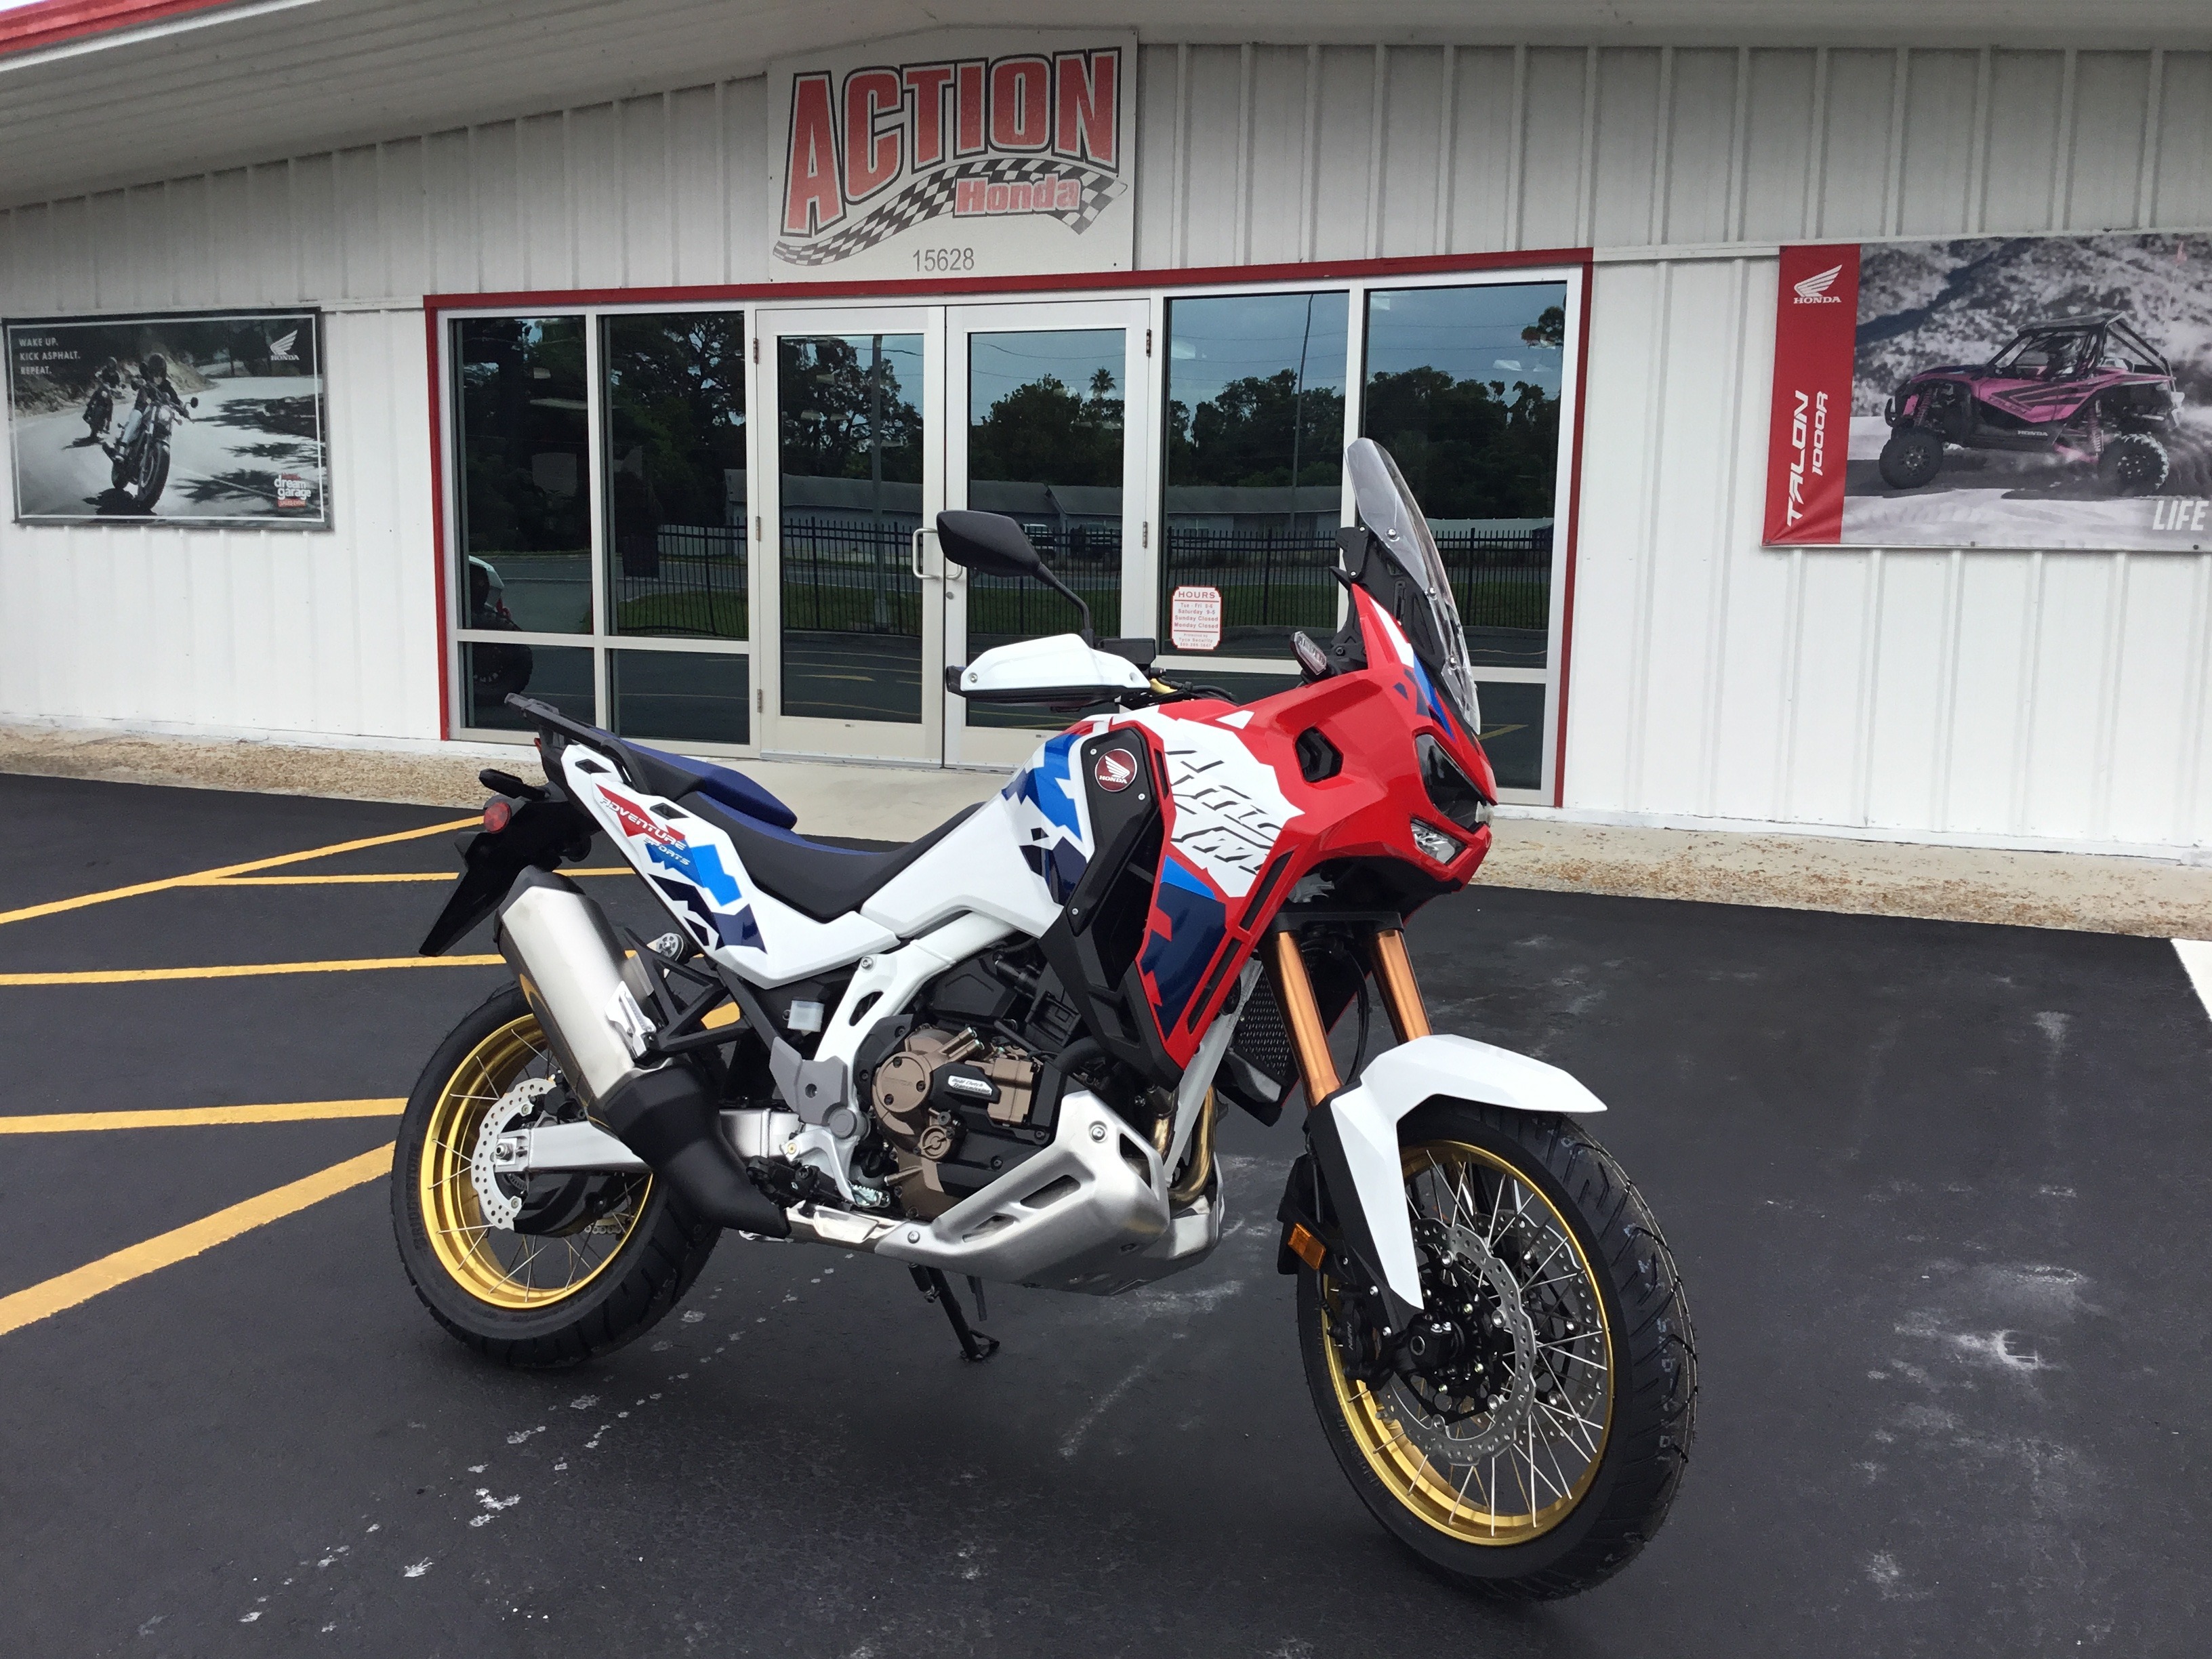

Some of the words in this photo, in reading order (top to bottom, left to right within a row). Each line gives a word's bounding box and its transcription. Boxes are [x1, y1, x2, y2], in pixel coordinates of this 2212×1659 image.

[781, 47, 1122, 237] ACTION
[954, 173, 1081, 216] Honda
[913, 248, 975, 272] 15628
[1793, 296, 1842, 304] HONDA
[19, 337, 42, 346] WAKE
[45, 337, 59, 346] UP.
[20, 352, 39, 361] KICK
[42, 350, 81, 360] ASPHALT.
[20, 366, 52, 375] REPEAT.
[1812, 391, 1828, 476] 1000R
[1787, 390, 1809, 527] TALON
[274, 474, 306, 489] dream
[278, 488, 311, 500] garage
[2152, 500, 2210, 531] LIFE
[1178, 591, 1216, 599] HOURS
[1099, 775, 1128, 784] HONDA
[600, 798, 687, 851] ADVENTURE
[643, 838, 691, 865] SPORTS
